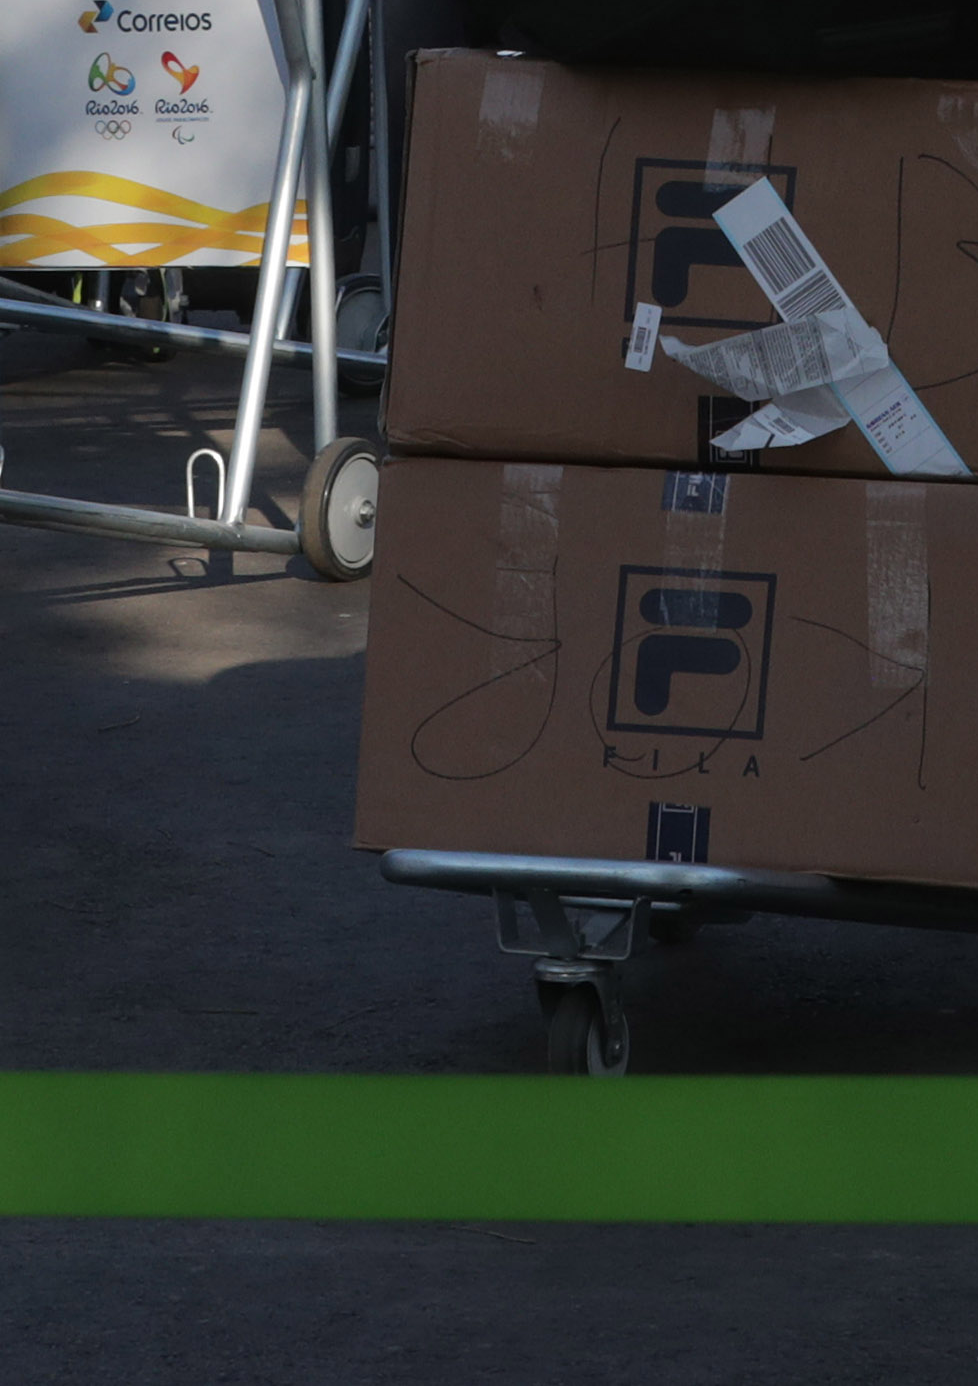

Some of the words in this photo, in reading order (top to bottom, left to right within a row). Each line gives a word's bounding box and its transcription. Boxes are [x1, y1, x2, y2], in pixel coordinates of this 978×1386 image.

[85, 99, 140, 116] Rio2016
[155, 98, 210, 115] Rio2016
[602, 745, 761, 779] FILA
